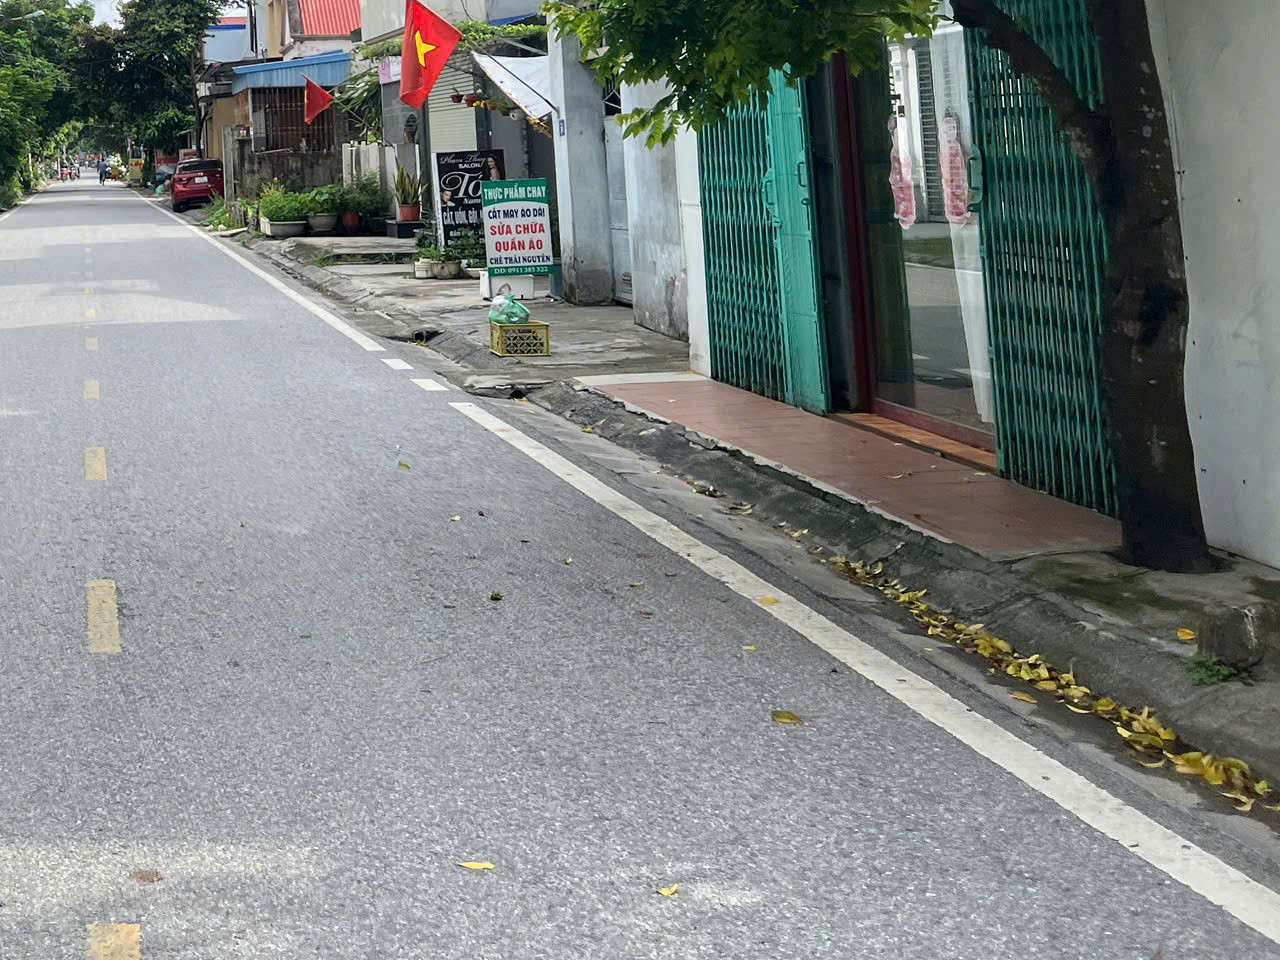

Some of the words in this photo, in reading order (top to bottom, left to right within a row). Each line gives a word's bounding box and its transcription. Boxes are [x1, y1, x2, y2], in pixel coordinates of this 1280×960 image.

[440, 171, 483, 198] Tó
[484, 187, 503, 201] THỰC
[504, 182, 525, 199] PHẨM
[527, 186, 546, 198] CHAY
[503, 209, 519, 219] MAY
[490, 221, 512, 235] SỬA
[515, 221, 545, 234] CHỮA
[495, 237, 525, 253] QUẦN
[529, 237, 543, 250] ÁO
[522, 253, 550, 264] NGUYÊN
